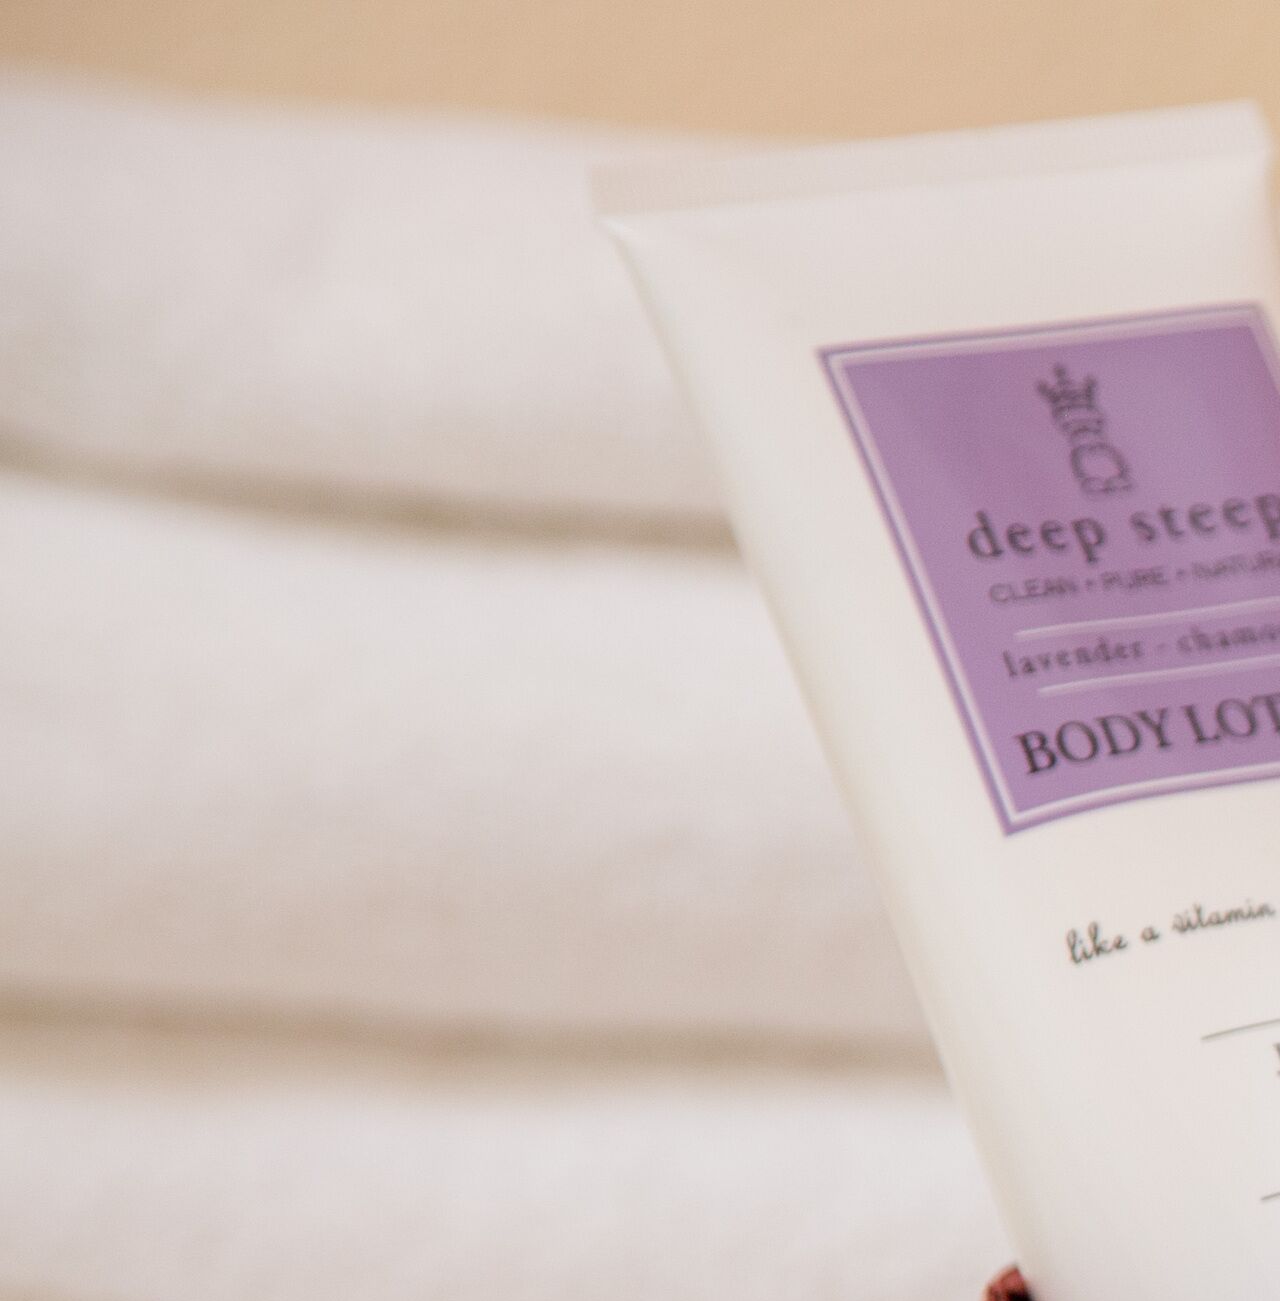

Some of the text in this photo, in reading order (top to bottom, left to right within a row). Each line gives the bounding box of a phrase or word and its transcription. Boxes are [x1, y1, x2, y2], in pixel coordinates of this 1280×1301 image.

[966, 510, 1106, 564] deep
[990, 577, 1079, 602] CLEAN
[1102, 566, 1168, 590] PURE
[1001, 635, 1144, 677] lavender
[1014, 707, 1173, 775] BODY
[1066, 921, 1128, 965] like
[1140, 926, 1160, 942] a
